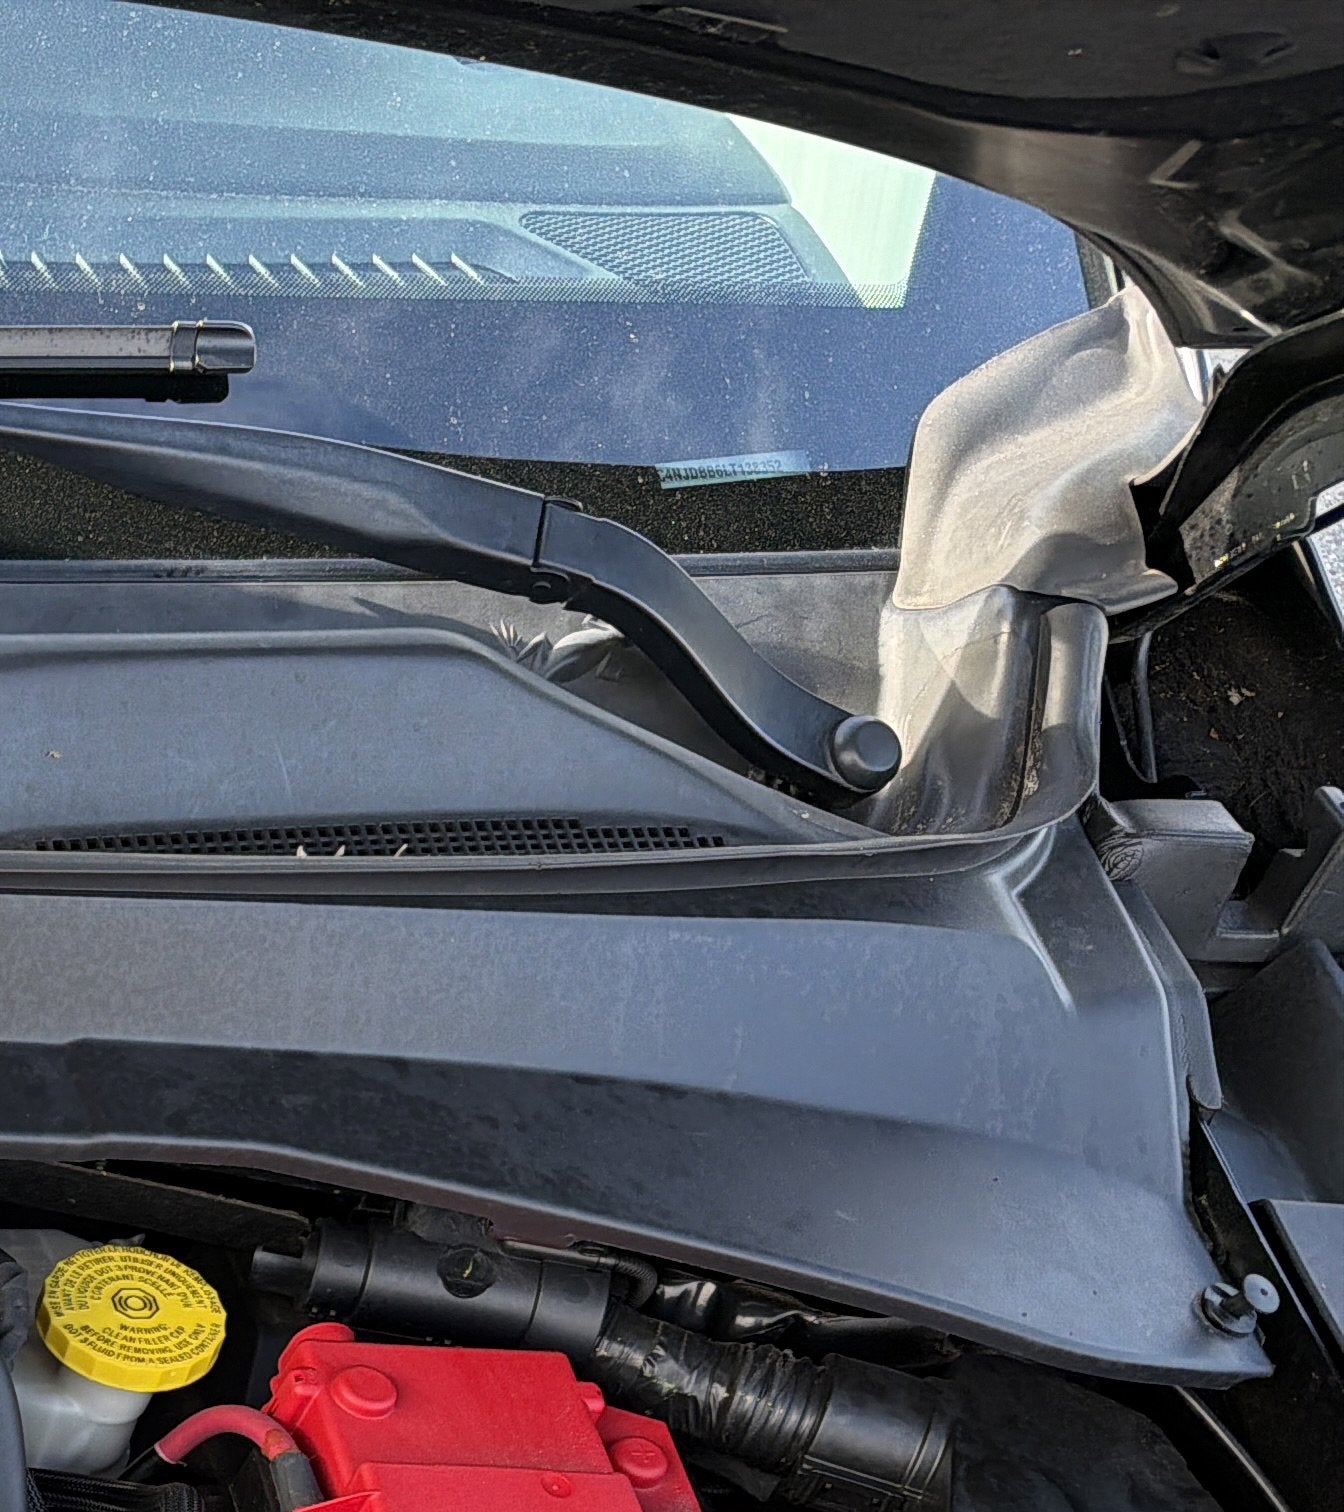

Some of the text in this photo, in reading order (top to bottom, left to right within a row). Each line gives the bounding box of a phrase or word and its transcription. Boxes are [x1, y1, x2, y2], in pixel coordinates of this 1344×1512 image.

[63, 1323, 84, 1338] DOT
[87, 1340, 116, 1357] FLUID
[116, 1353, 146, 1363] FROM
[157, 1351, 193, 1365] SEALED
[80, 1324, 117, 1348] BEFORE
[173, 1337, 193, 1350] USE
[102, 1325, 186, 1346] CLEAN FILLER CAP
